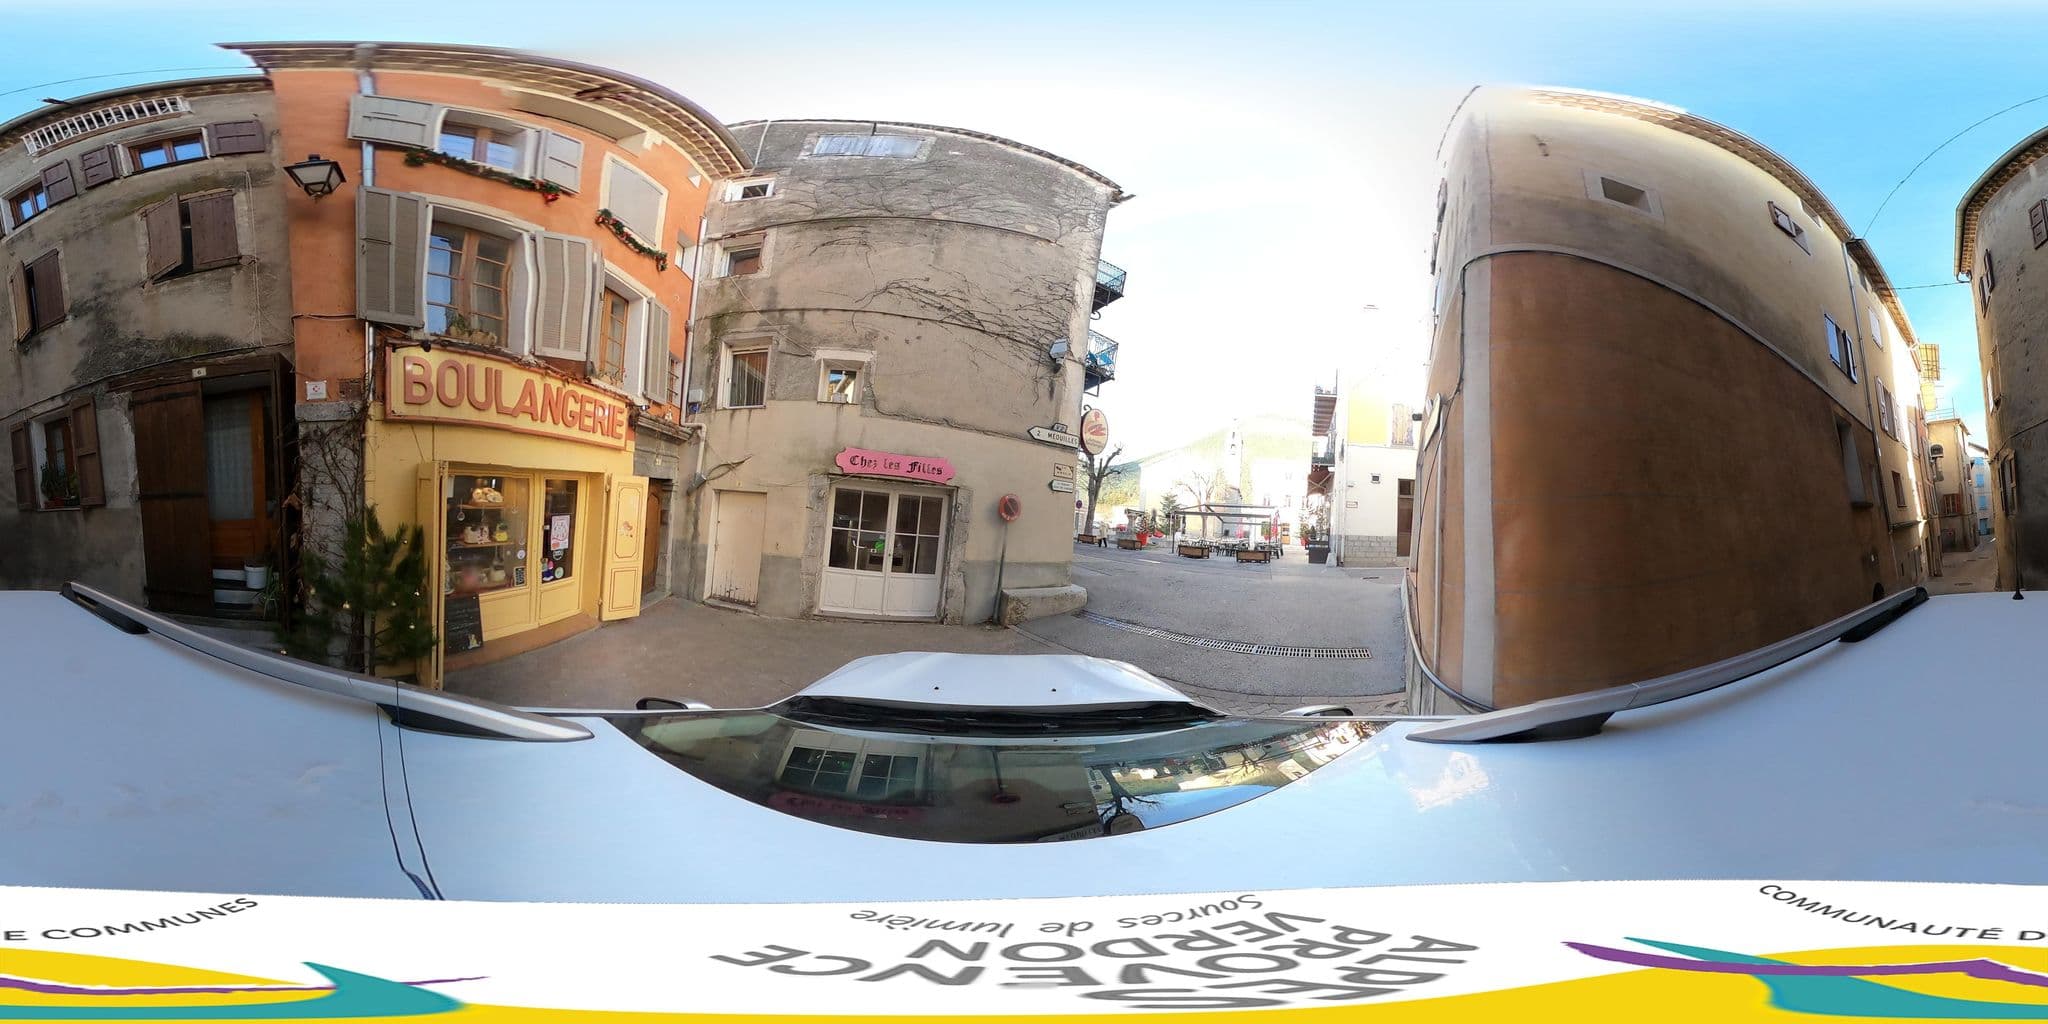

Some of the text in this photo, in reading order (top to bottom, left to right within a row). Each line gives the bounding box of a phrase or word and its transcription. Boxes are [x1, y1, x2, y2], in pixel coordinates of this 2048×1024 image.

[404, 356, 625, 440] BOULANGERIE
[849, 455, 943, 475] Chez les Filles
